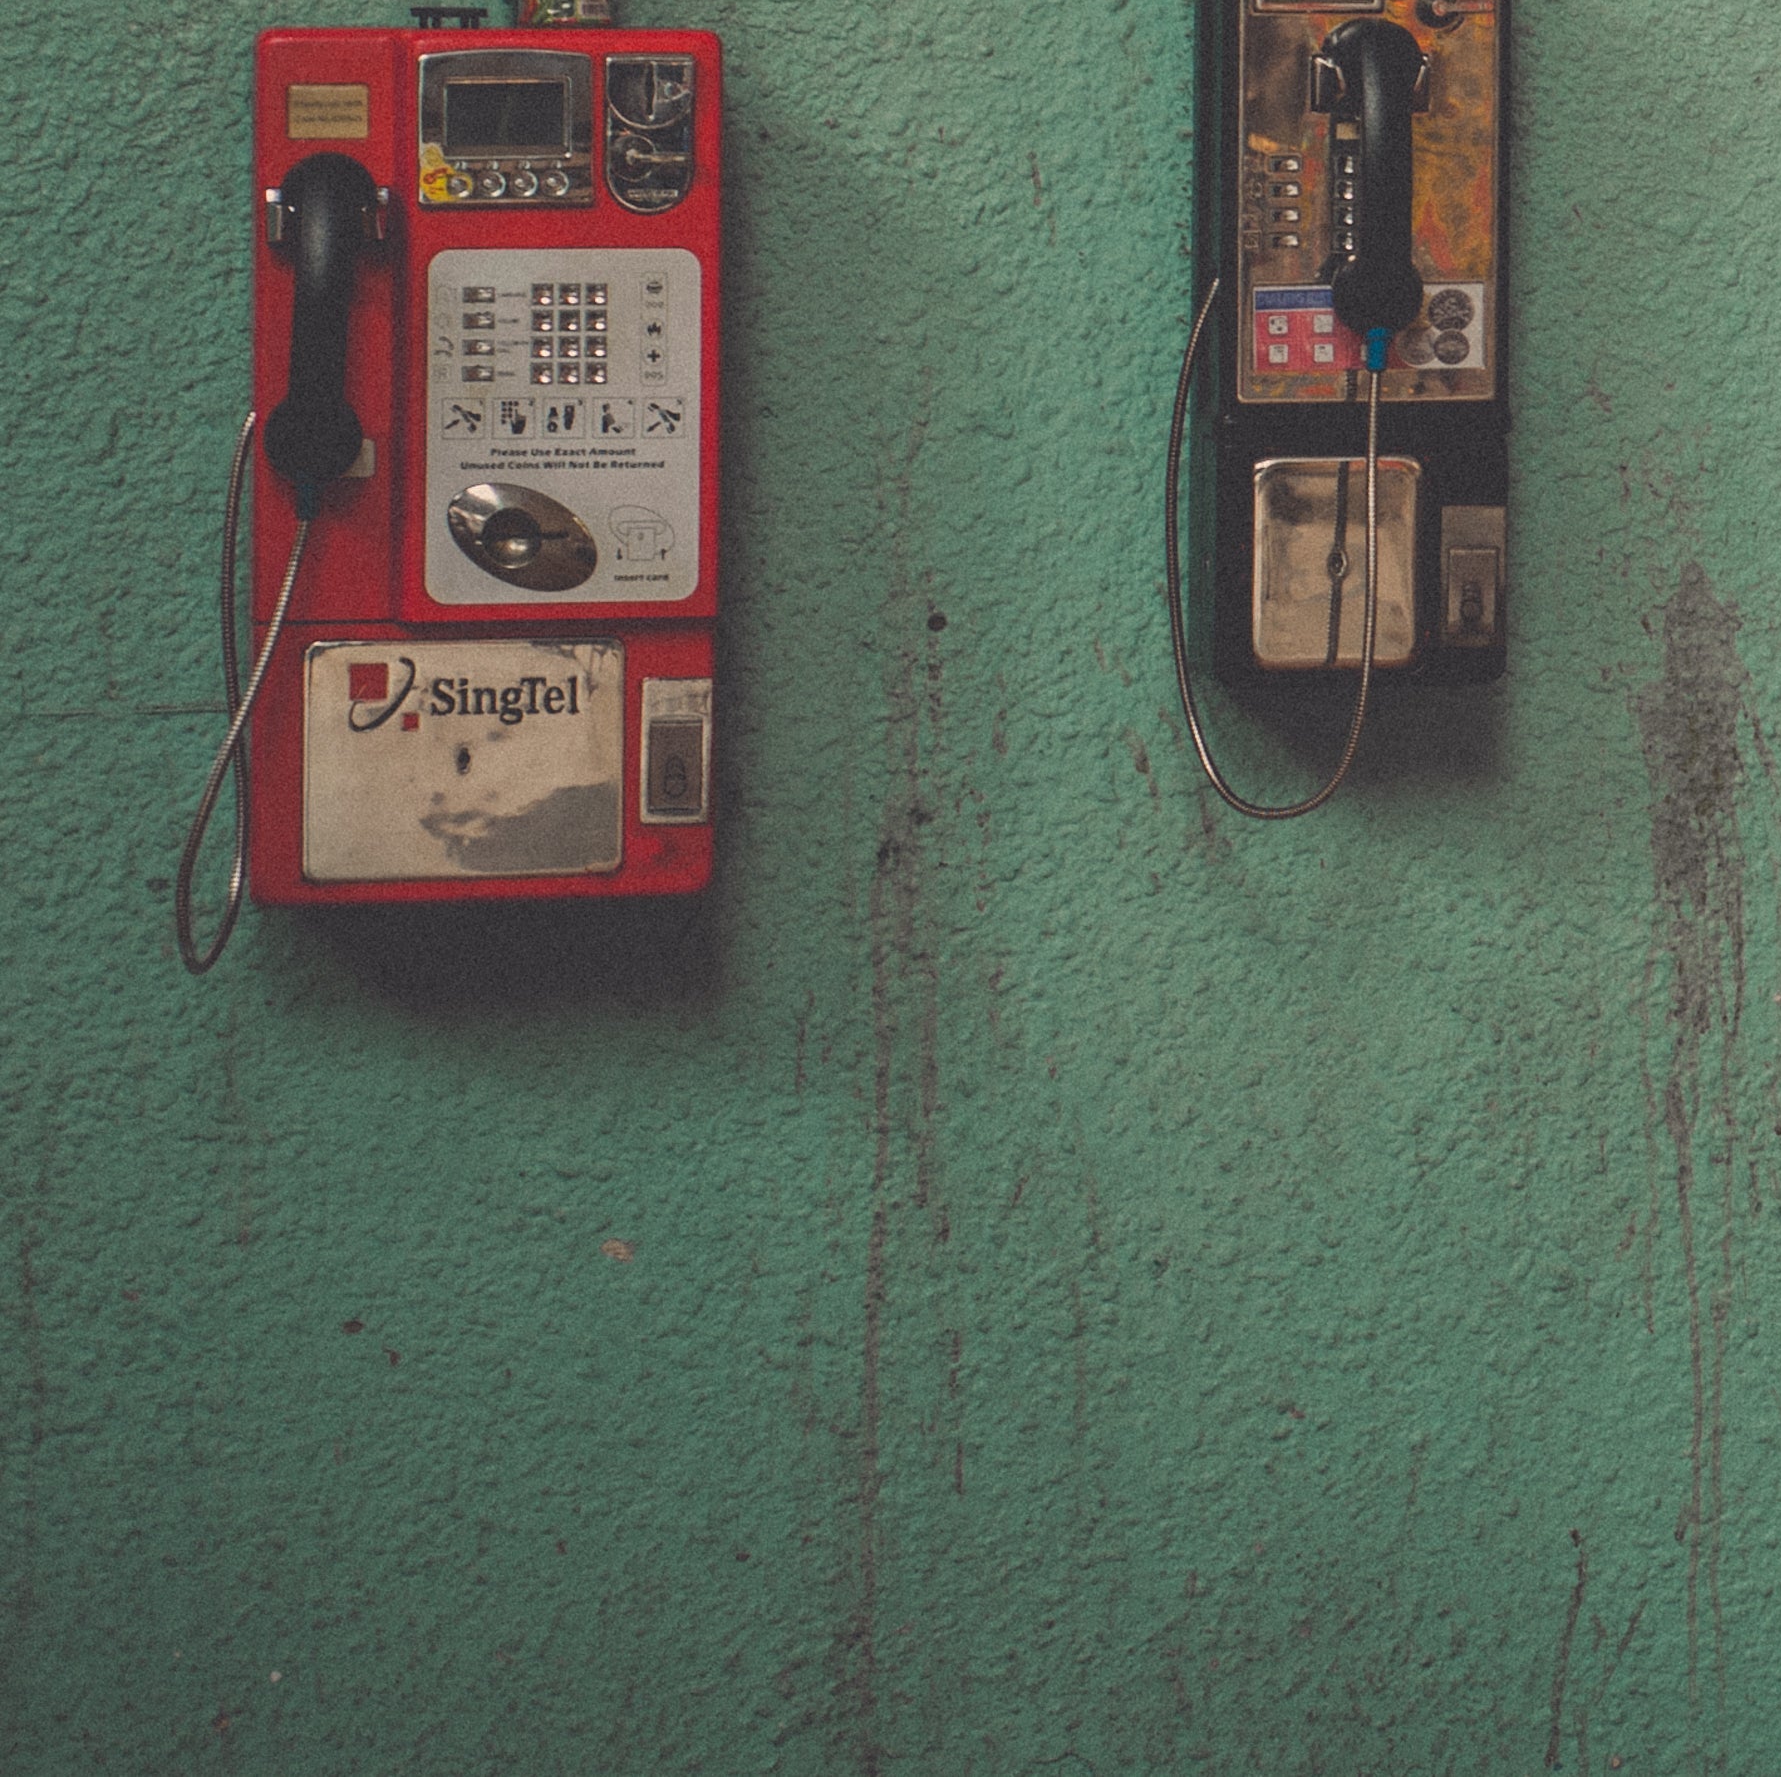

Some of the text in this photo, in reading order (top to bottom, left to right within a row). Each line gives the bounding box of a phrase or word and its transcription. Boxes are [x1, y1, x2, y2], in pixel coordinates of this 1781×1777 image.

[490, 447, 636, 457] Please Use Exact Amount
[460, 460, 665, 470] Unused Coins Will Not Be Returned
[430, 674, 580, 725] SingTel
